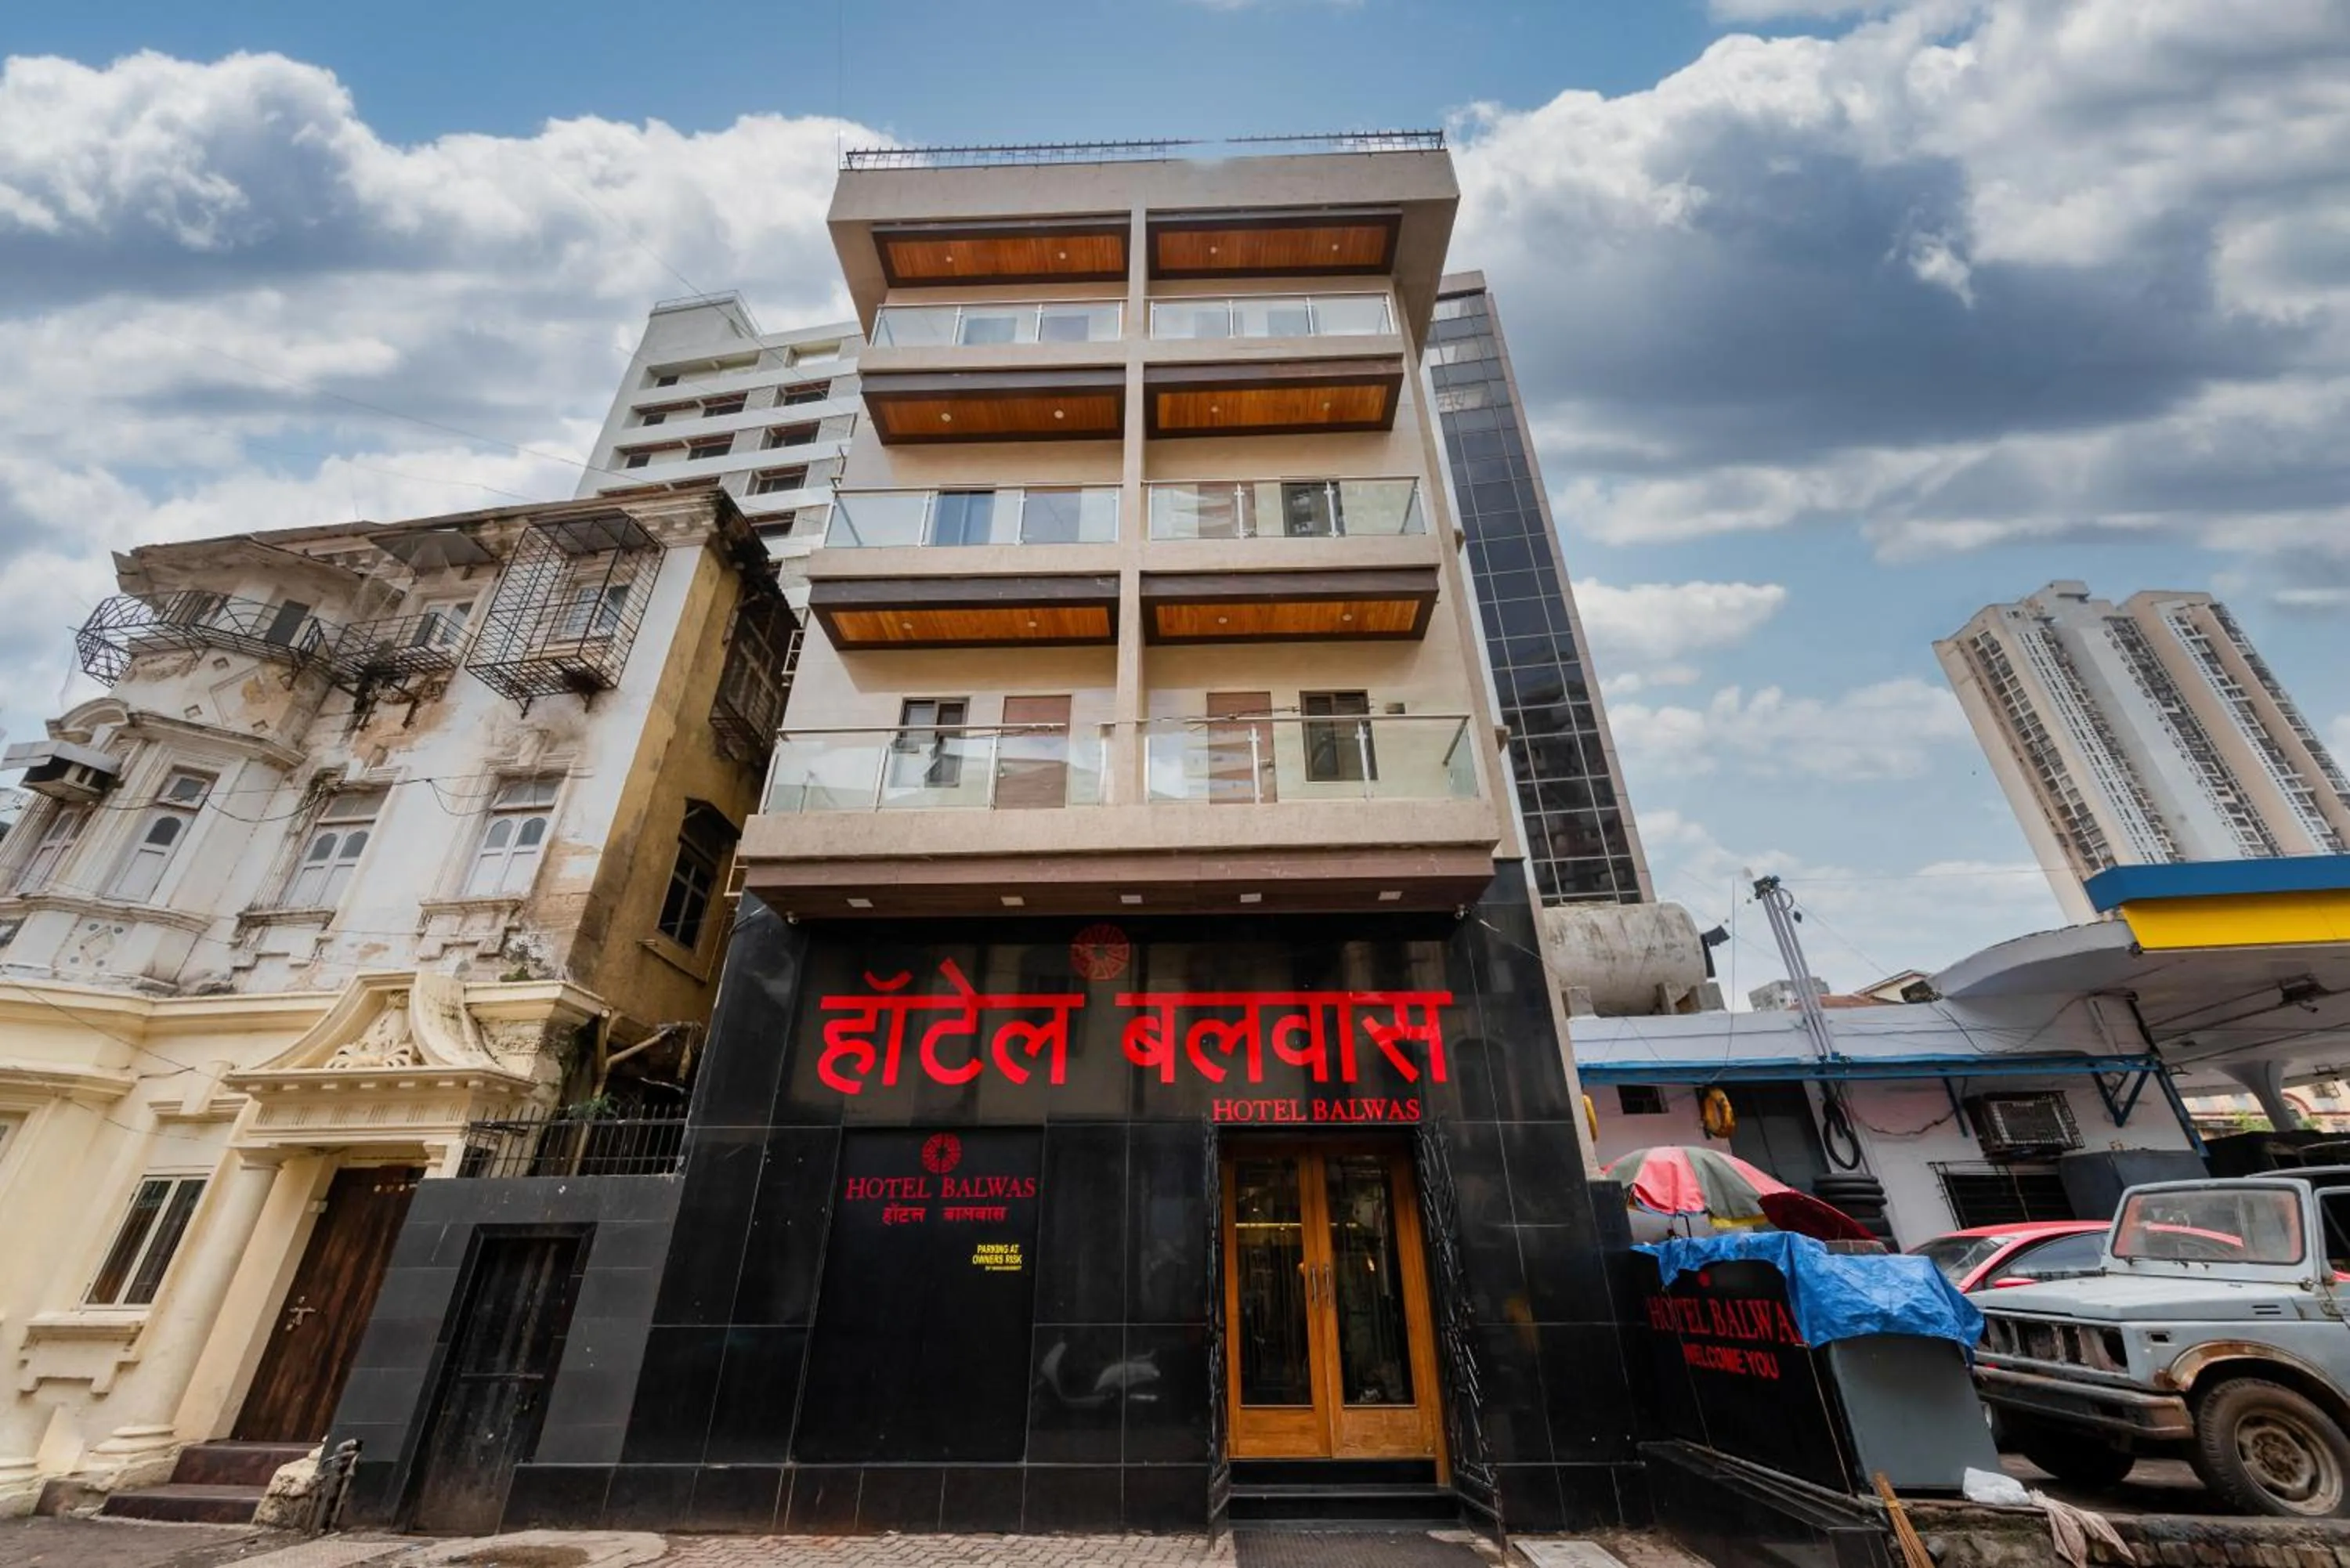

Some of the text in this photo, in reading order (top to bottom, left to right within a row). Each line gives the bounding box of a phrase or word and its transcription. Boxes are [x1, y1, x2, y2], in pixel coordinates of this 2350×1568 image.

[817, 957, 1454, 1095] हॉटेल बलवास
[1212, 1098, 1421, 1122] HOTEL BALWAS
[845, 1176, 1036, 1200] HOTEL BALWAS
[972, 1254, 1022, 1265] OWNERS RISK
[977, 1244, 1020, 1254] PARKING AT
[1647, 1297, 1804, 1343] HOTEL BALWA
[1683, 1342, 1780, 1379] WELCOME YOU
